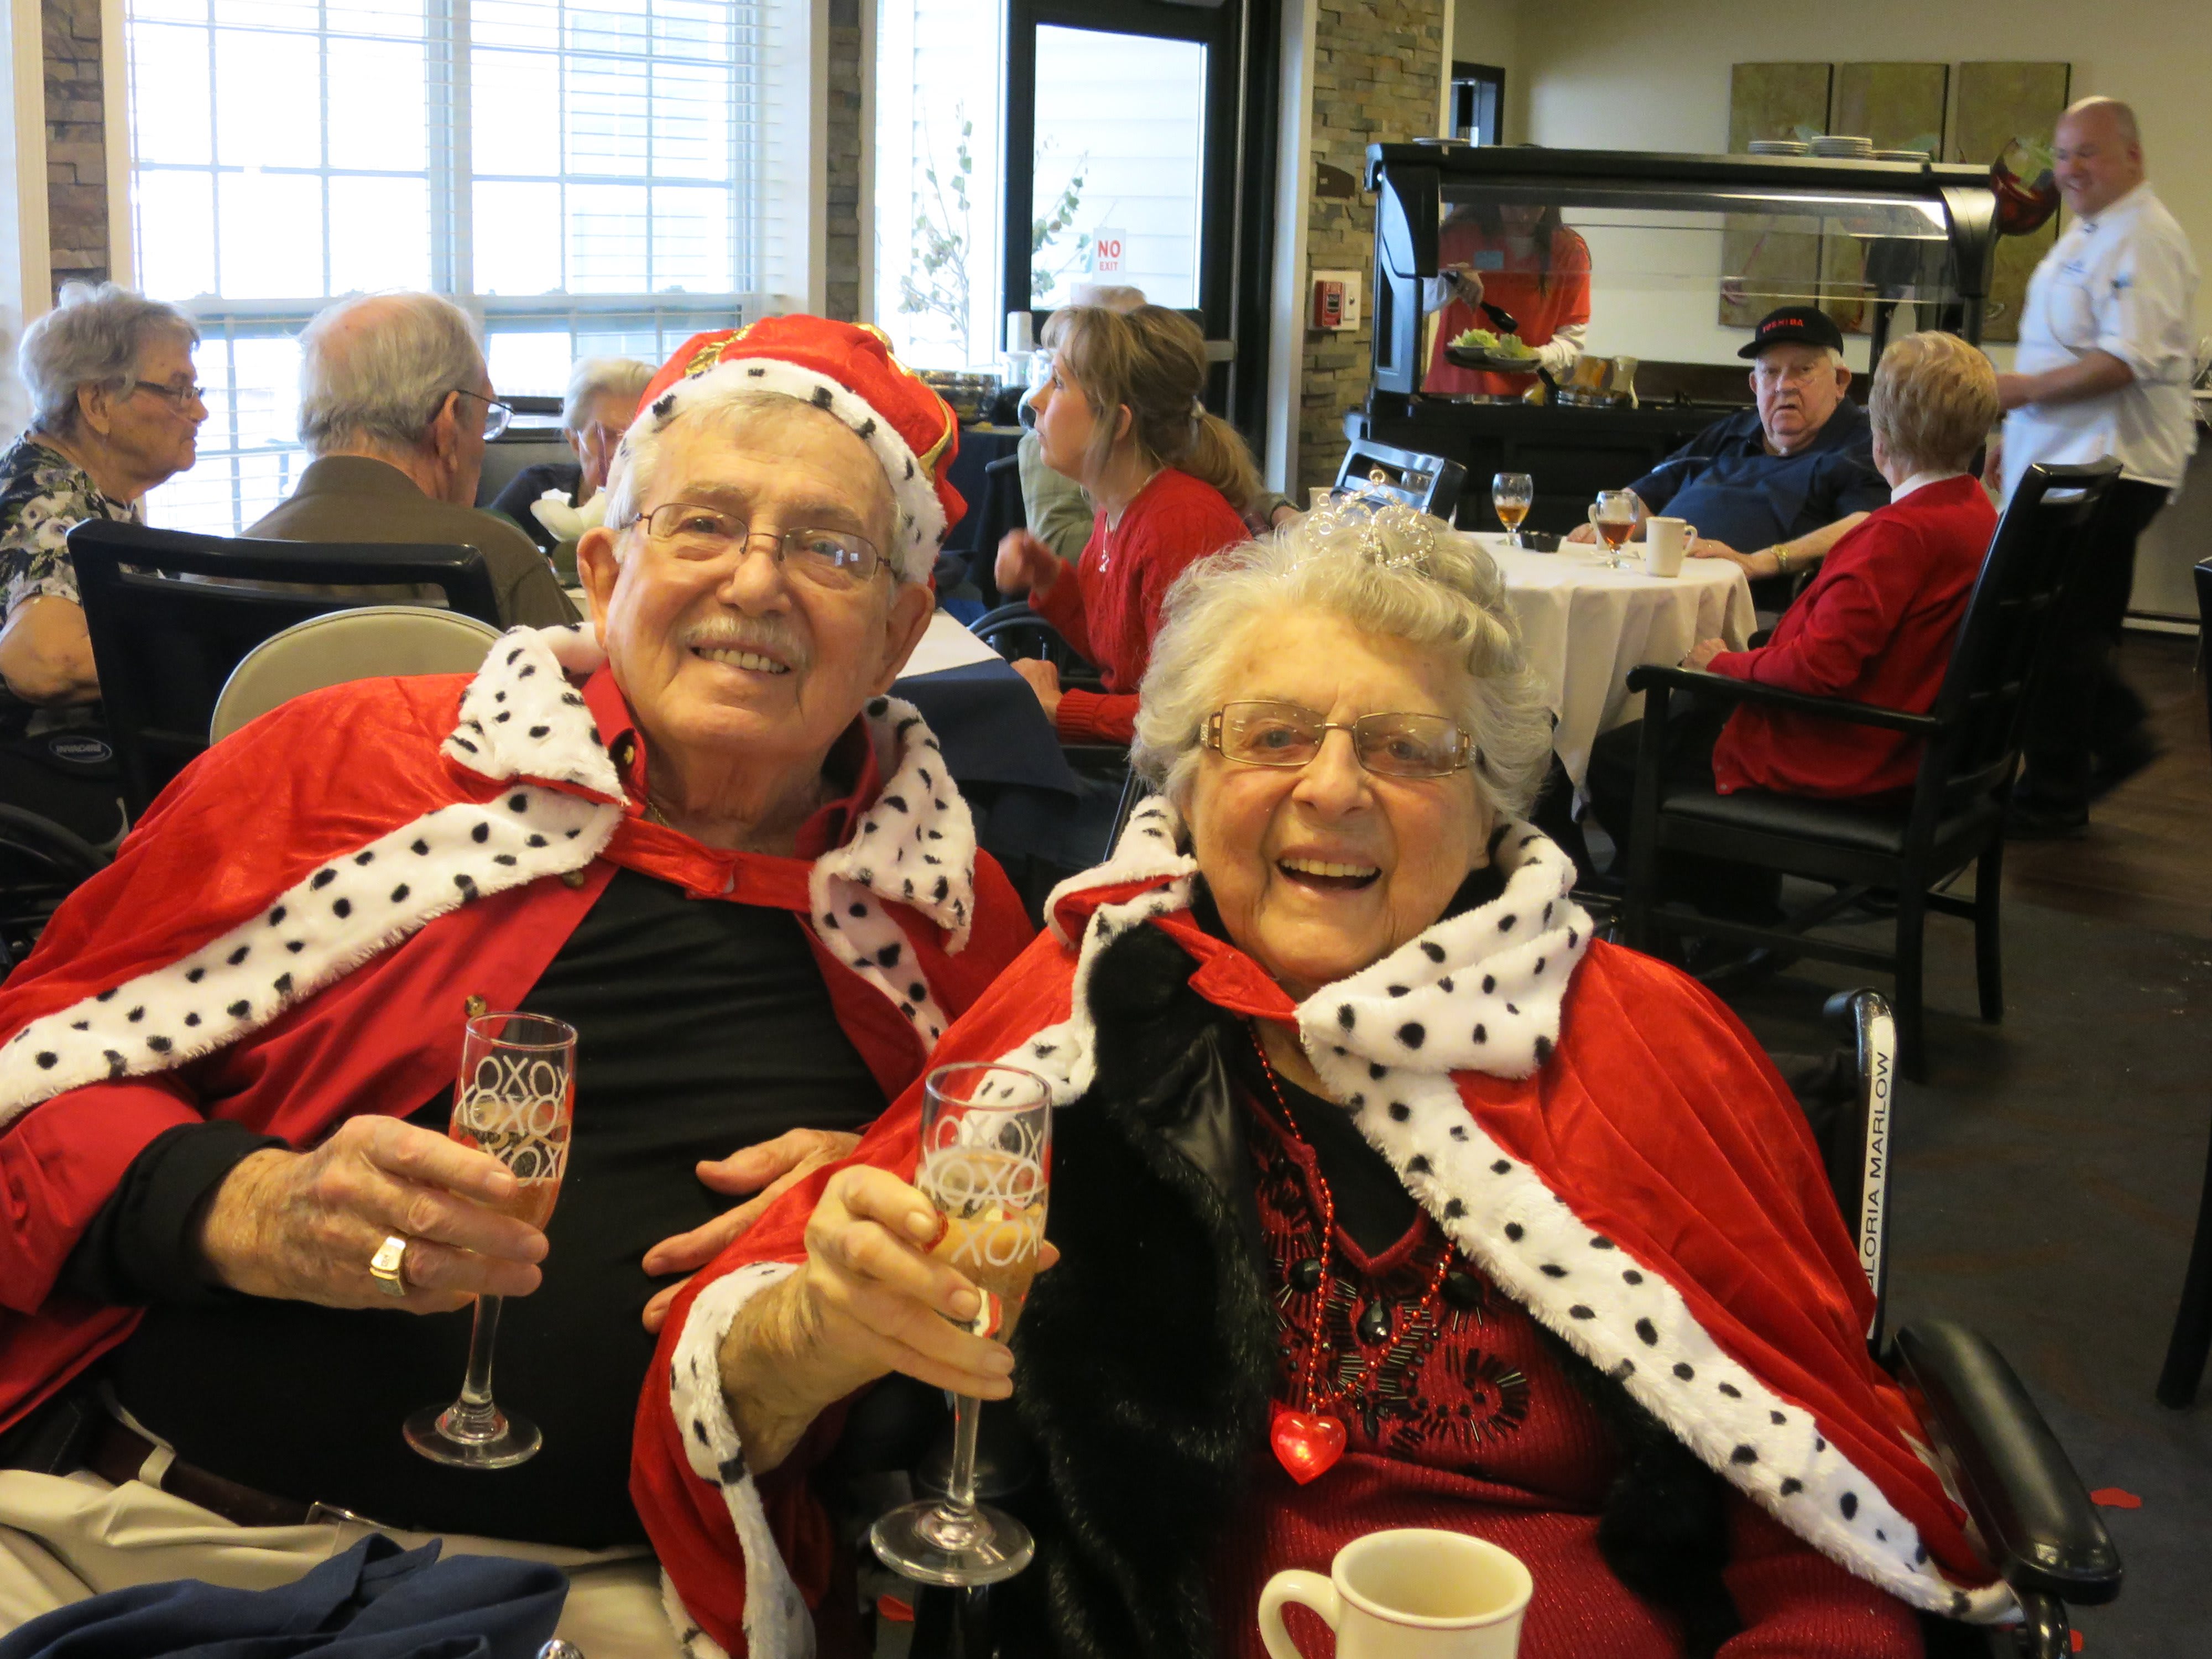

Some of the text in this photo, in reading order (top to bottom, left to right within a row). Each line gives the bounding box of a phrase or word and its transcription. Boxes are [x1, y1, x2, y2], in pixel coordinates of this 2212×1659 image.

[1098, 239, 1120, 258] NO
[1099, 262, 1118, 271] EXIT
[1870, 1051, 1890, 1178] MARLOW
